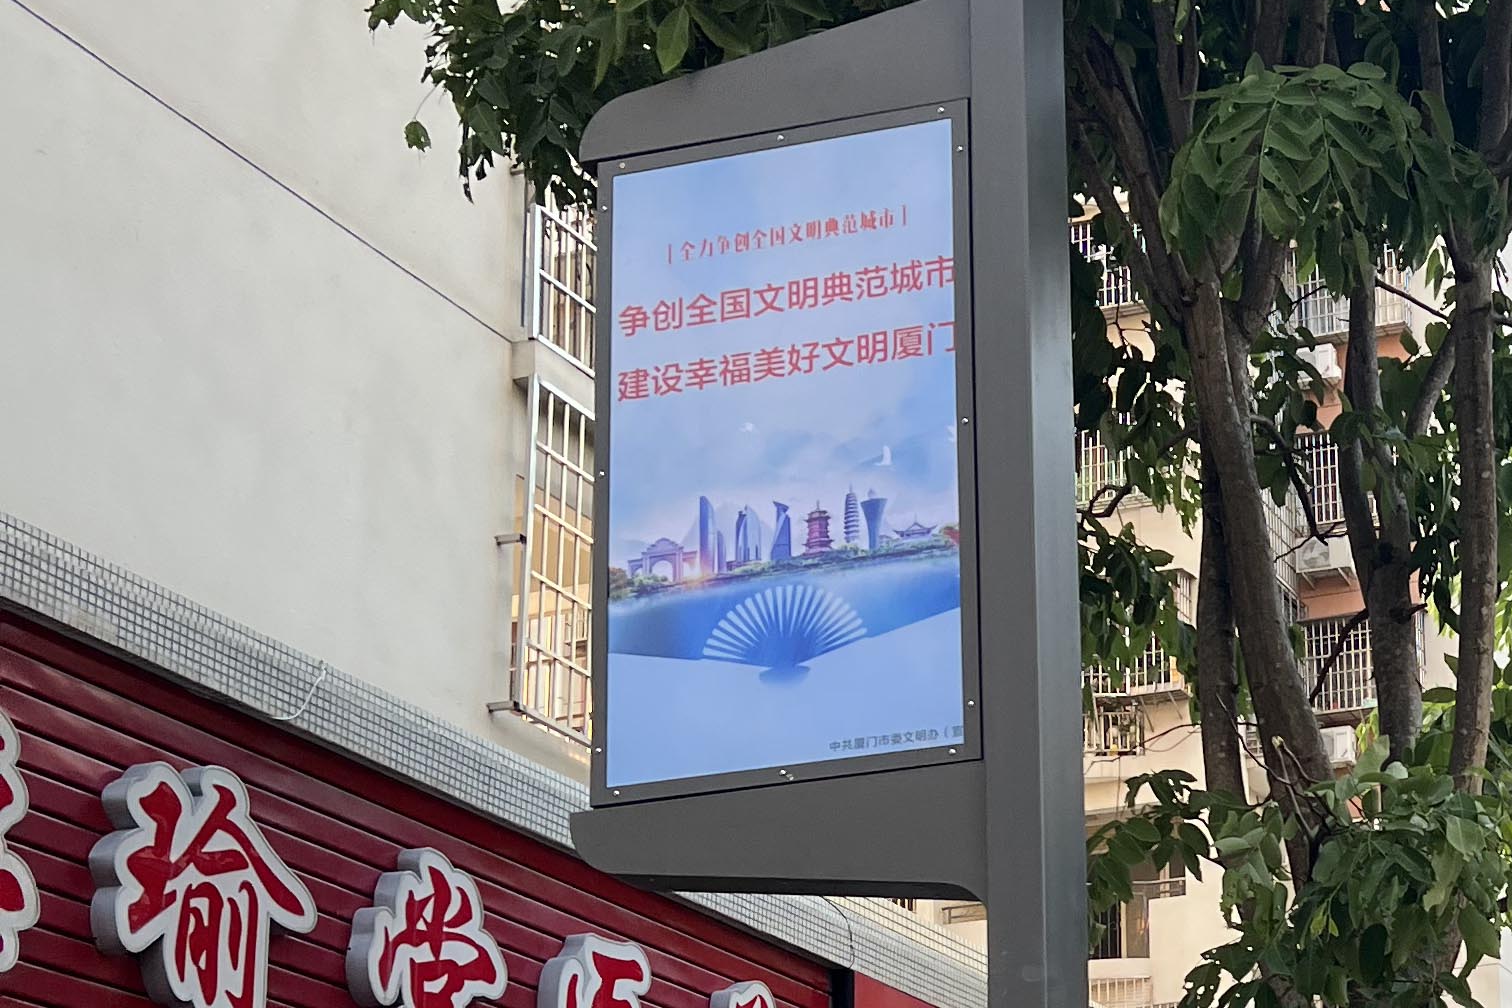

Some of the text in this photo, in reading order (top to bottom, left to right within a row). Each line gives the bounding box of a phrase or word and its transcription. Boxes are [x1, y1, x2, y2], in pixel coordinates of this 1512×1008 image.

[618, 254, 957, 338] 争创全国文明典范城市
[617, 321, 958, 403] 建设幸福美好文明厦门
